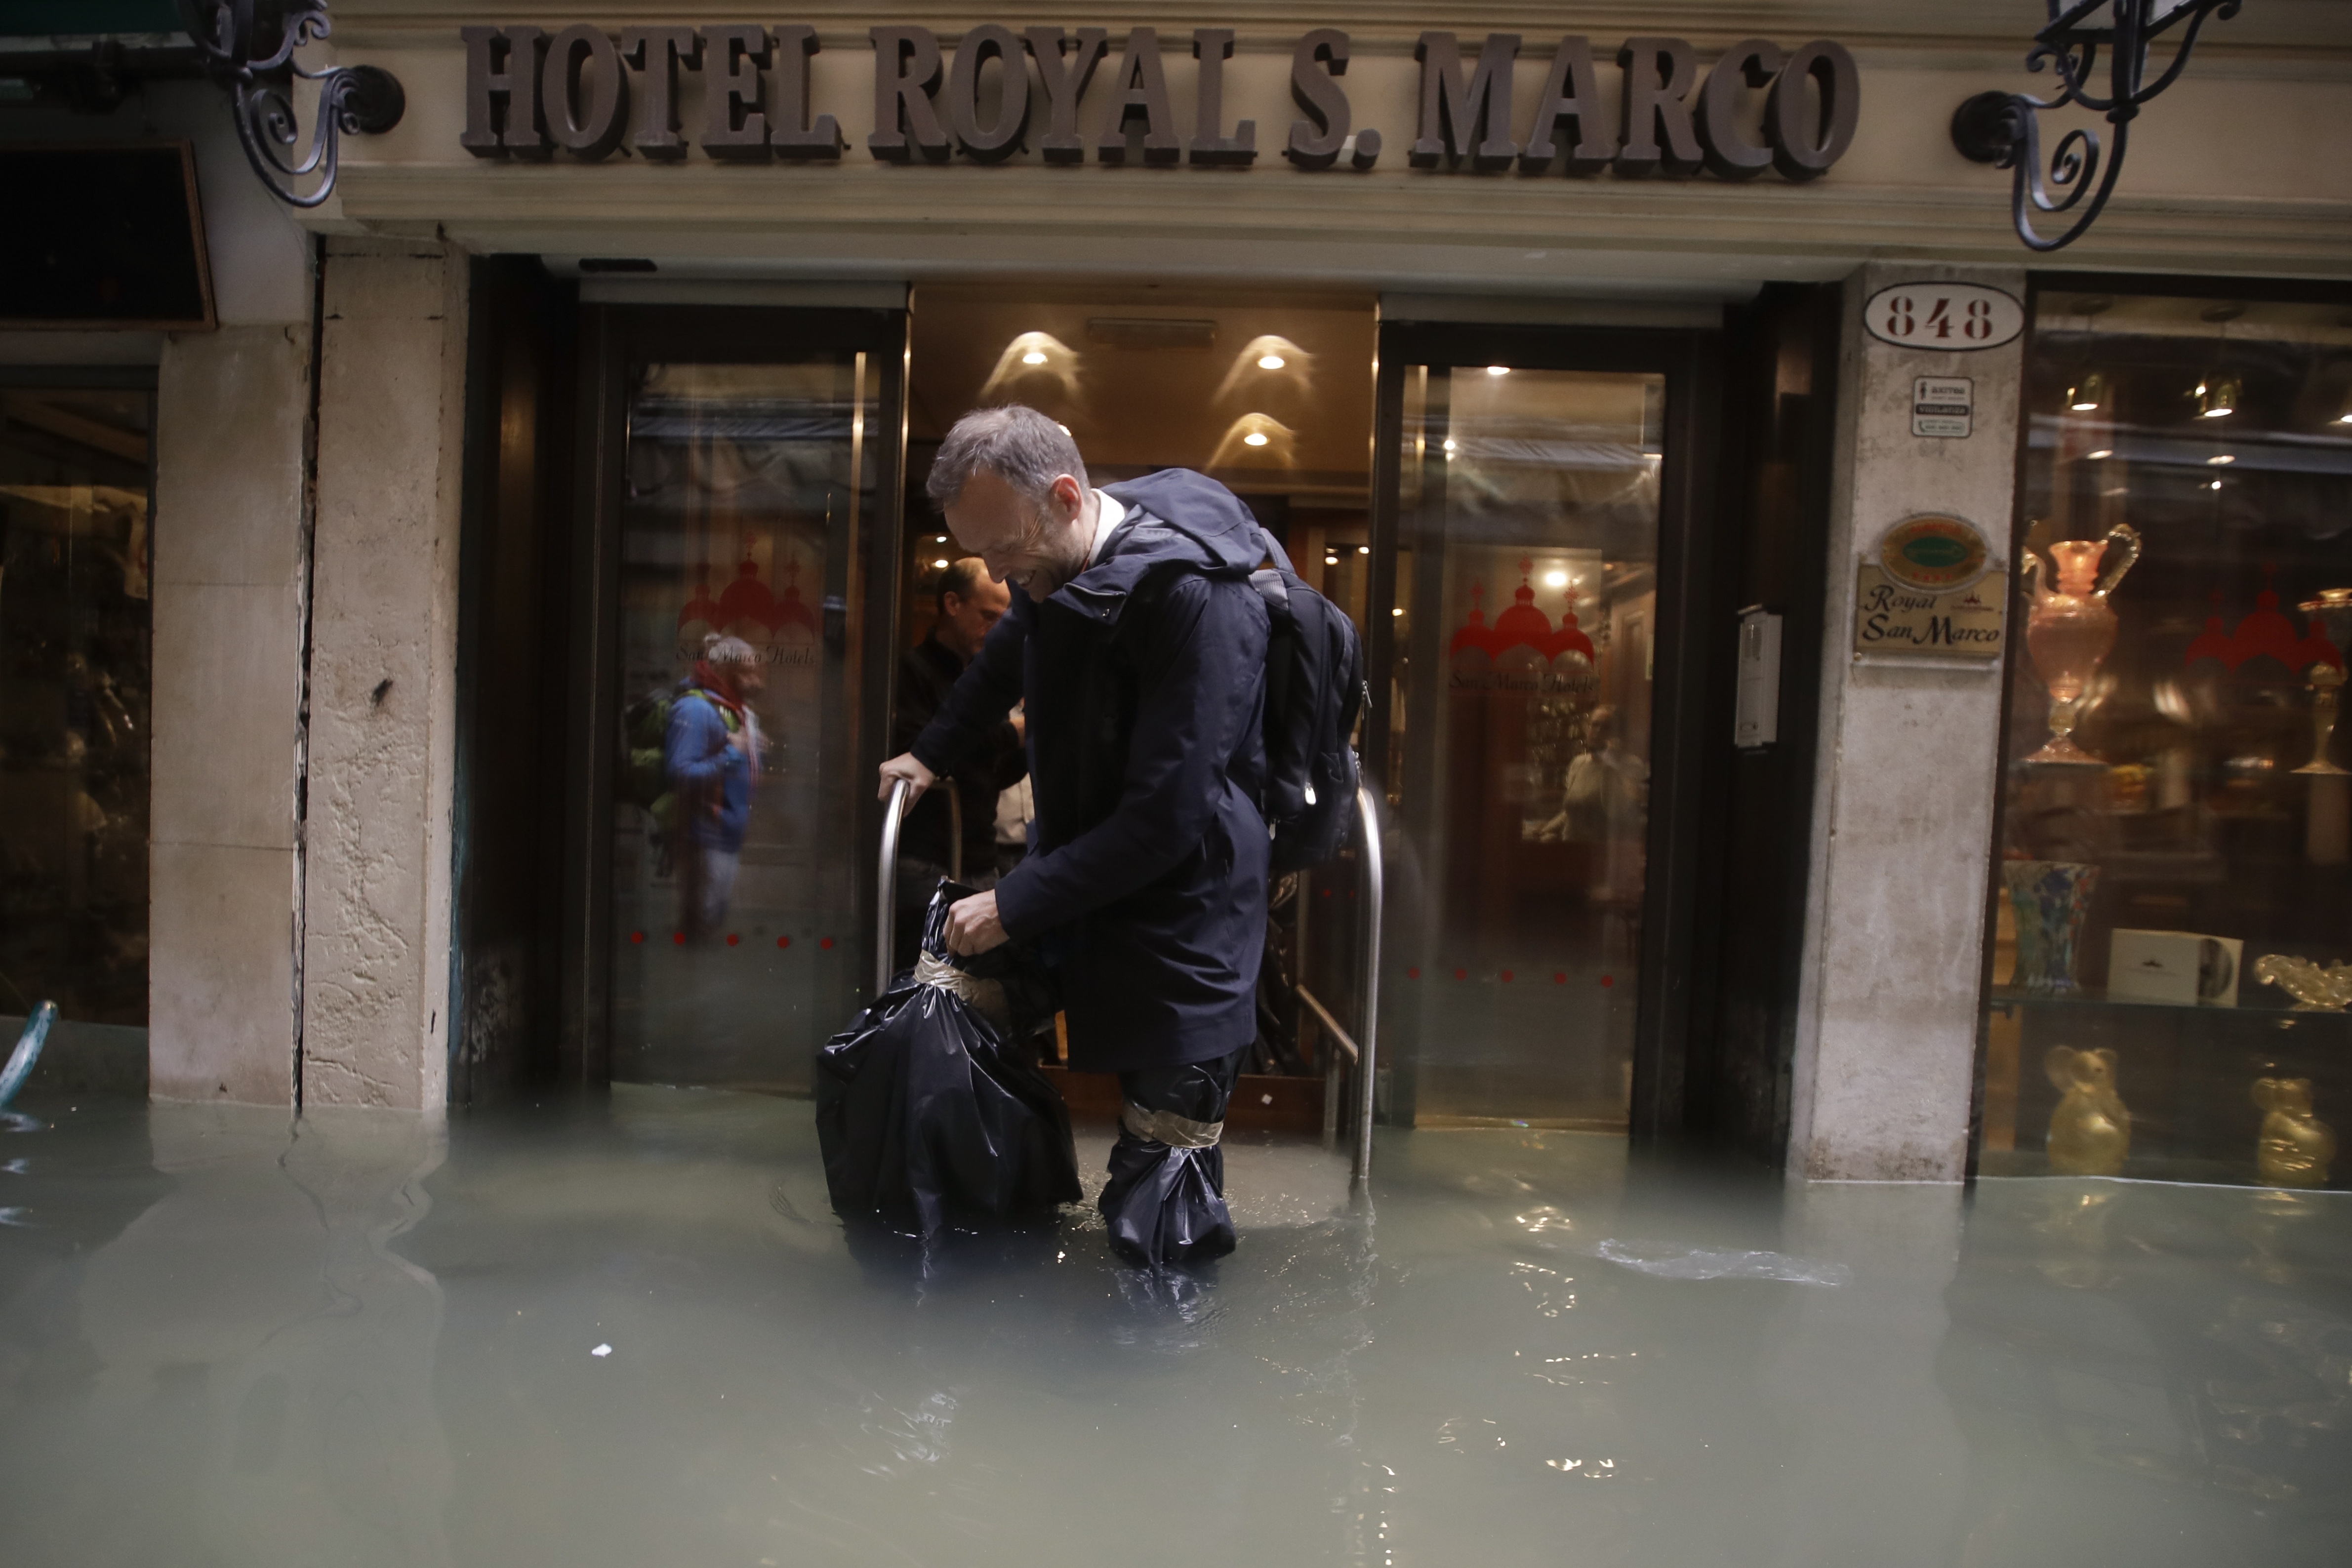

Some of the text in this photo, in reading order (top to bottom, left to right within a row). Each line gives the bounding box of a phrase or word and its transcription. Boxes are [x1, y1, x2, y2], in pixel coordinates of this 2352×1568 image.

[460, 24, 1861, 182] HOTEL ROYAL S. MARCO
[1887, 296, 1993, 339] 848
[1864, 584, 1938, 612] Royal
[1862, 613, 2000, 645] San Marco
[710, 645, 761, 663] Marco
[766, 645, 815, 665] Hotels
